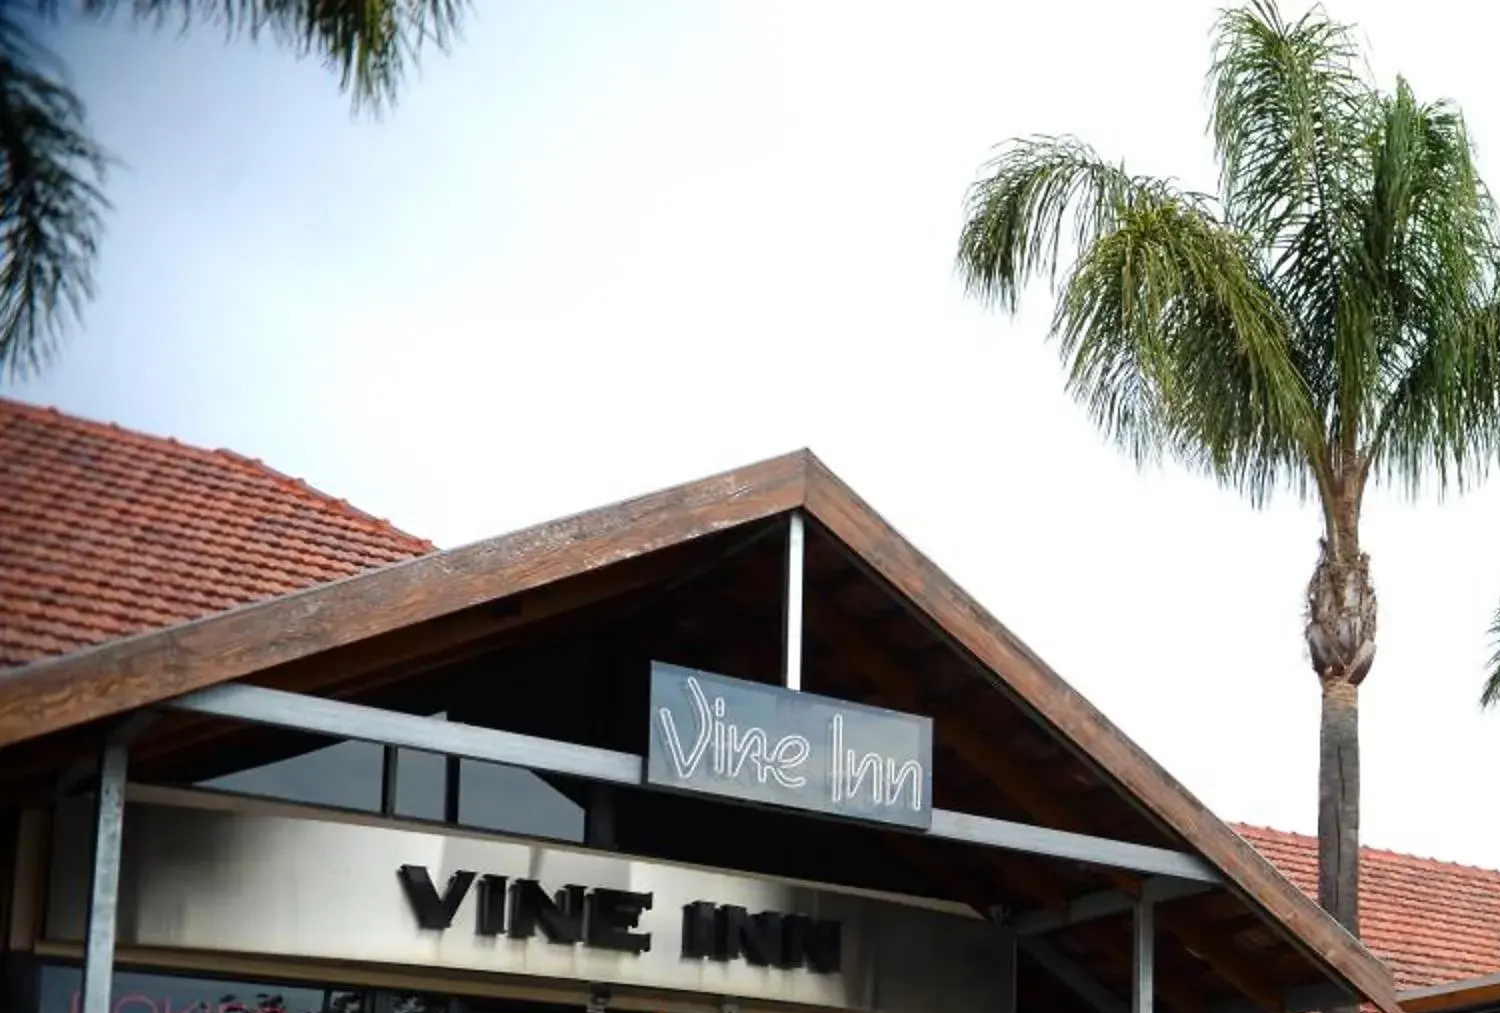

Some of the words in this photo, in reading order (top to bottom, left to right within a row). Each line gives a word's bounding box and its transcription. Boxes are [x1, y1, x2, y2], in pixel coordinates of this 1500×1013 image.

[659, 676, 811, 788] Vine
[832, 713, 922, 810] Inn
[397, 863, 653, 956] VINE
[680, 900, 841, 973] INN
